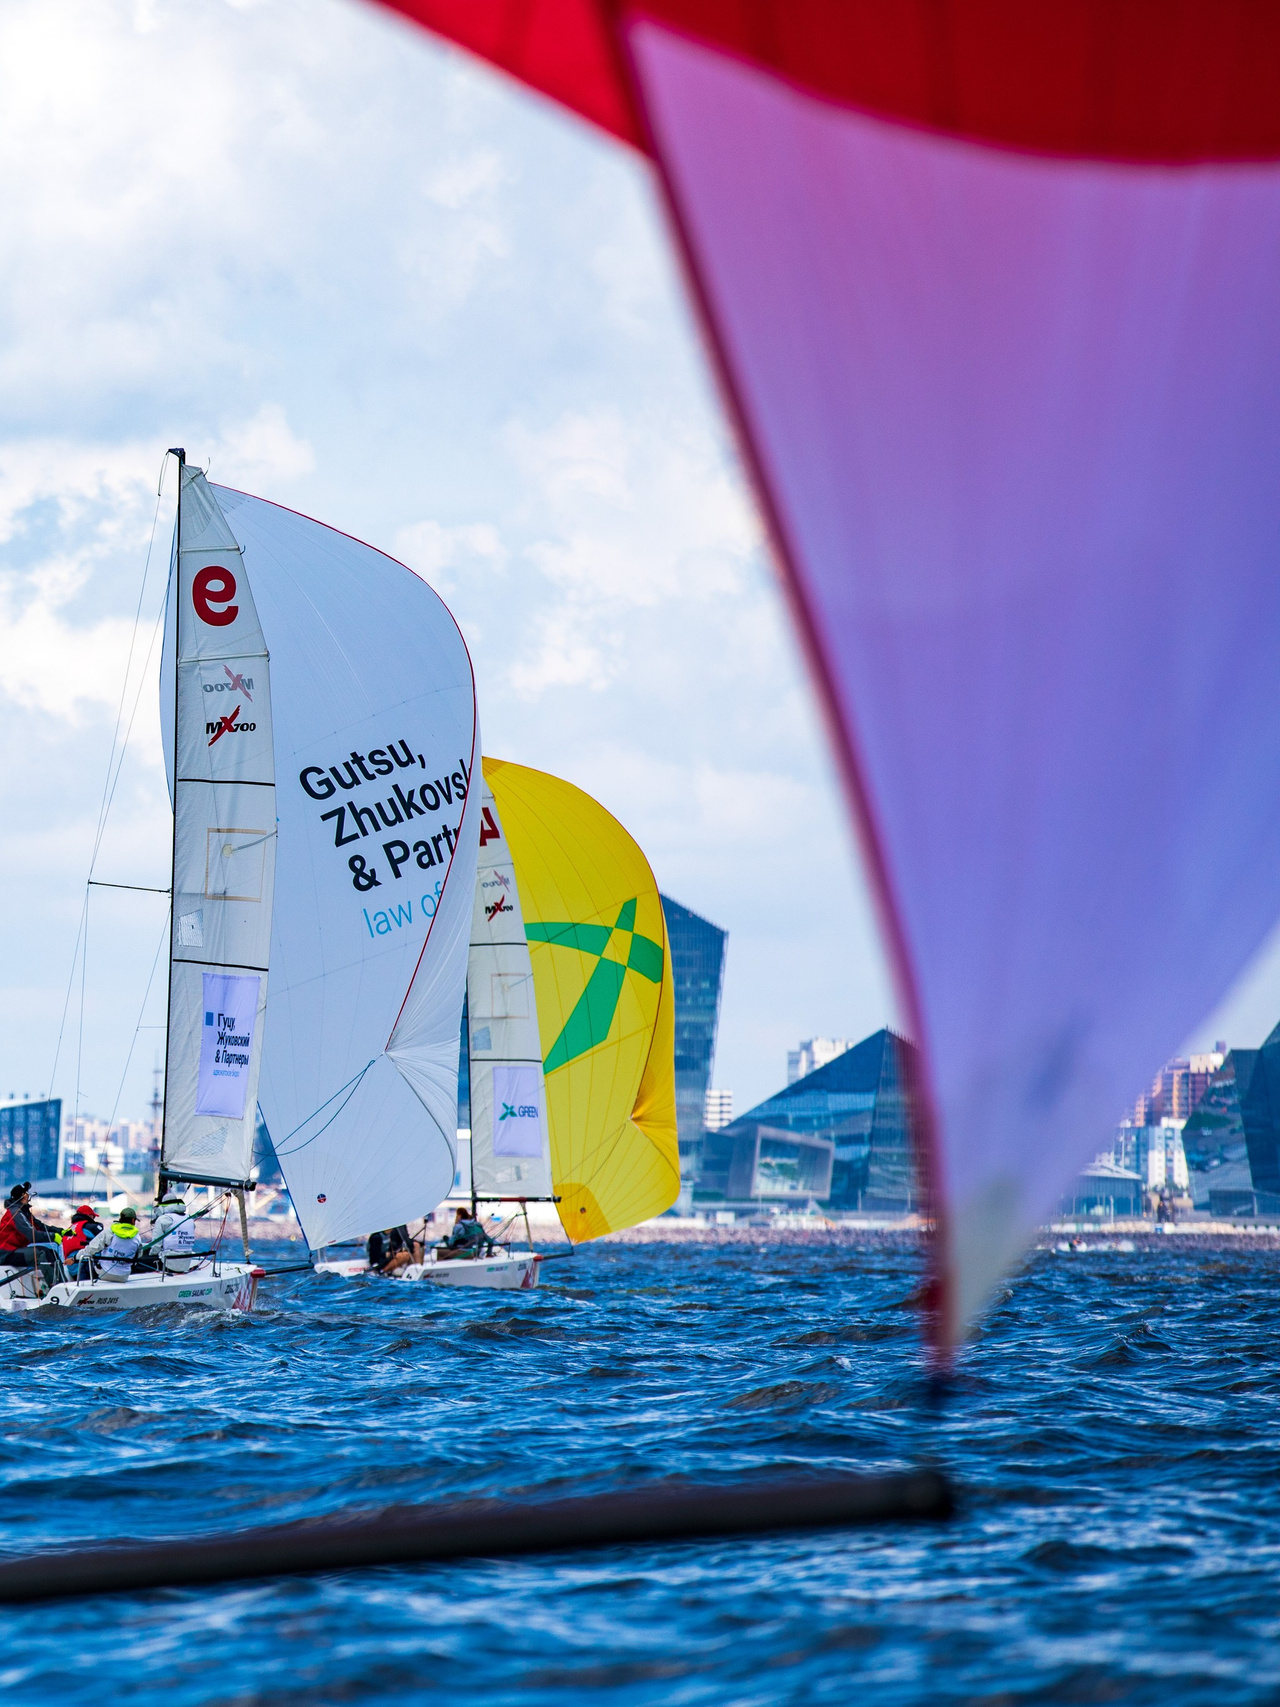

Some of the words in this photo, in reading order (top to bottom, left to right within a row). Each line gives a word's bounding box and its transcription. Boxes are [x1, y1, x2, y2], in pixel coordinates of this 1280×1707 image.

[206, 705, 256, 747] MX700
[299, 739, 426, 800] Gutsu,
[348, 854, 382, 892] &
[363, 900, 413, 938] law
[214, 1049, 221, 1063] &
